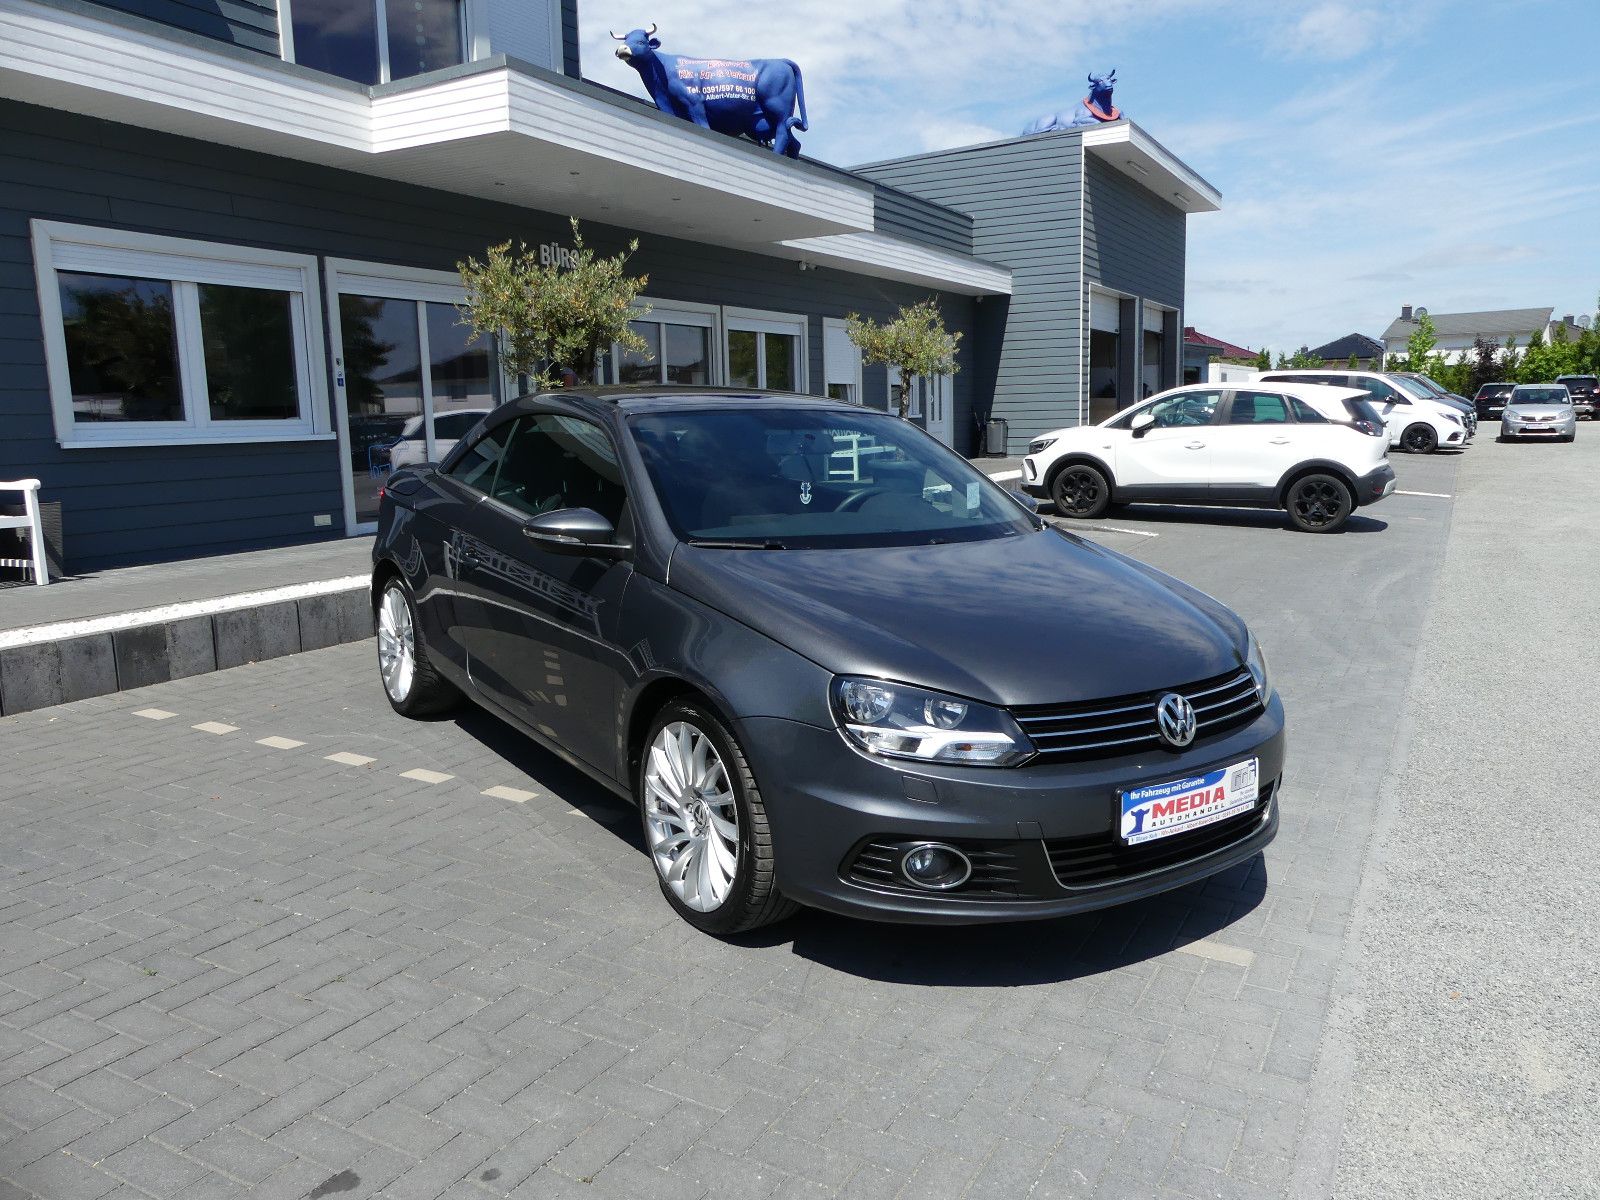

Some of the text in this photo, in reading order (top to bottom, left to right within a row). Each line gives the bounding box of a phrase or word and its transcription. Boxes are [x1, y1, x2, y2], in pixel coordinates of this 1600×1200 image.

[686, 86, 701, 94] Tel.
[702, 84, 734, 94] 0391/597
[745, 86, 756, 95] 100
[1130, 778, 1205, 800] Ihr Fahrzeug mit Garantie
[1152, 786, 1225, 819] MEDIA
[1151, 803, 1224, 828] AUTOHANDEL
